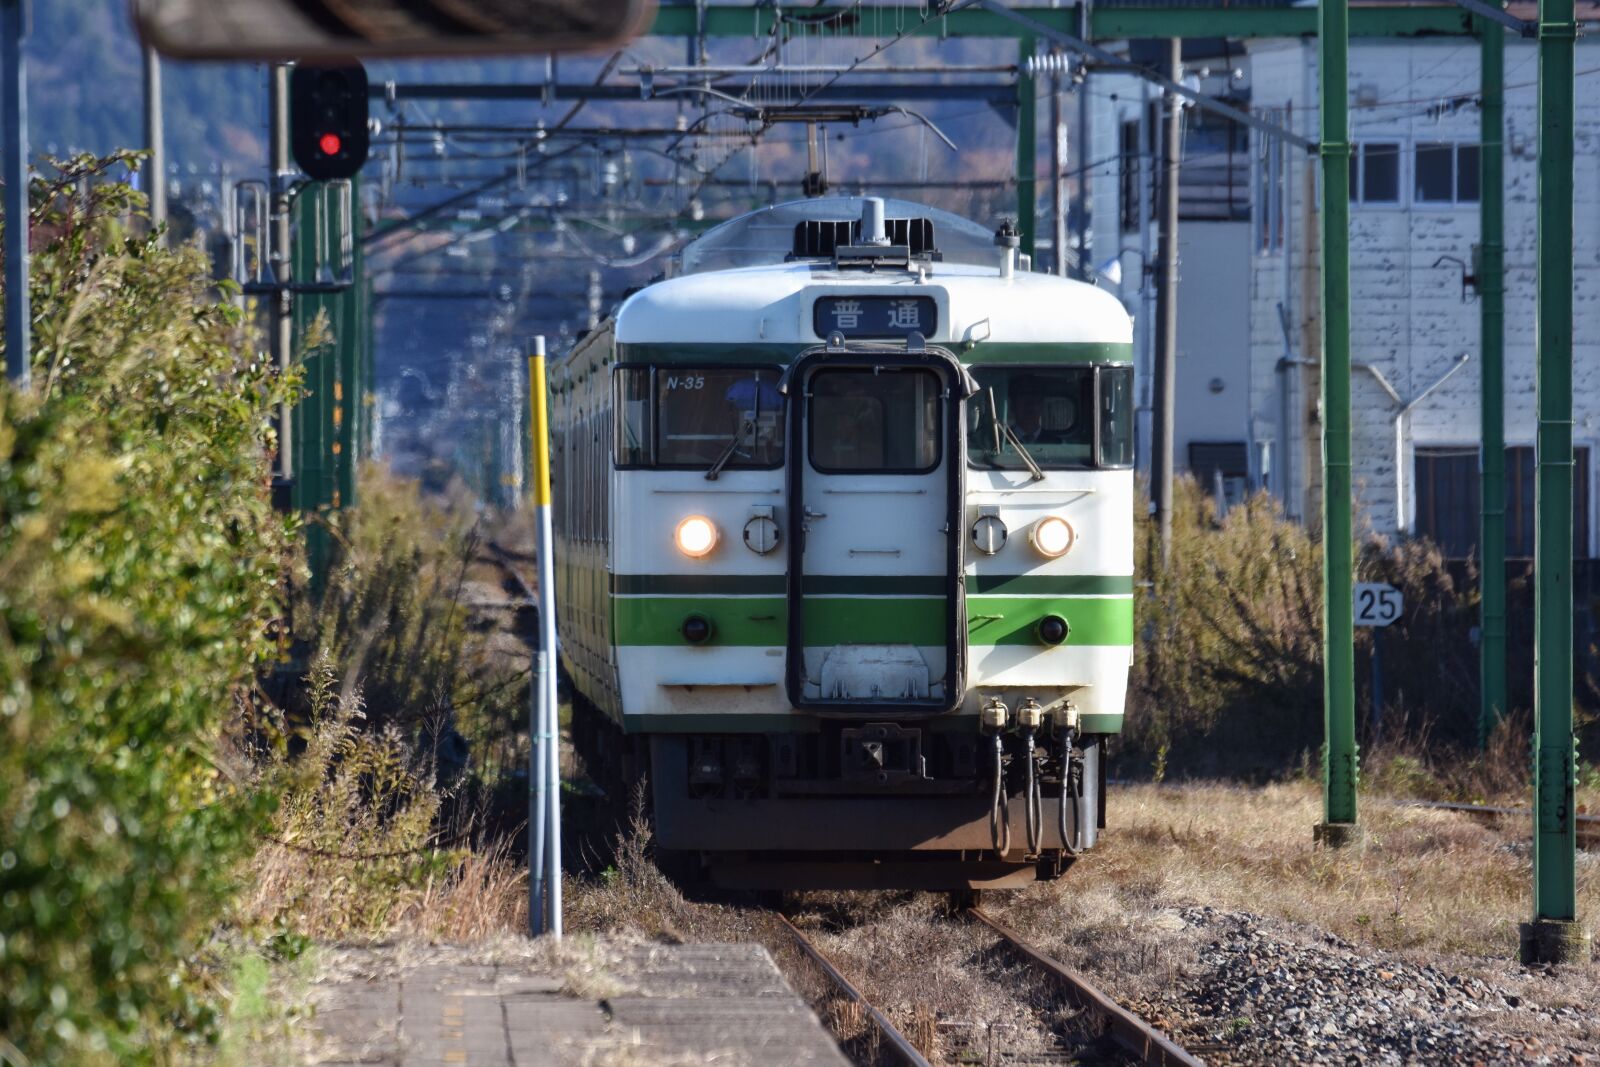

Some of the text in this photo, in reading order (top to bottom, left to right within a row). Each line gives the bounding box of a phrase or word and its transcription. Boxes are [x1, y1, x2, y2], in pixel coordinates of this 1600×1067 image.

[831, 300, 920, 328] 普通
[666, 376, 705, 390] N-35
[1360, 589, 1396, 620] 25
